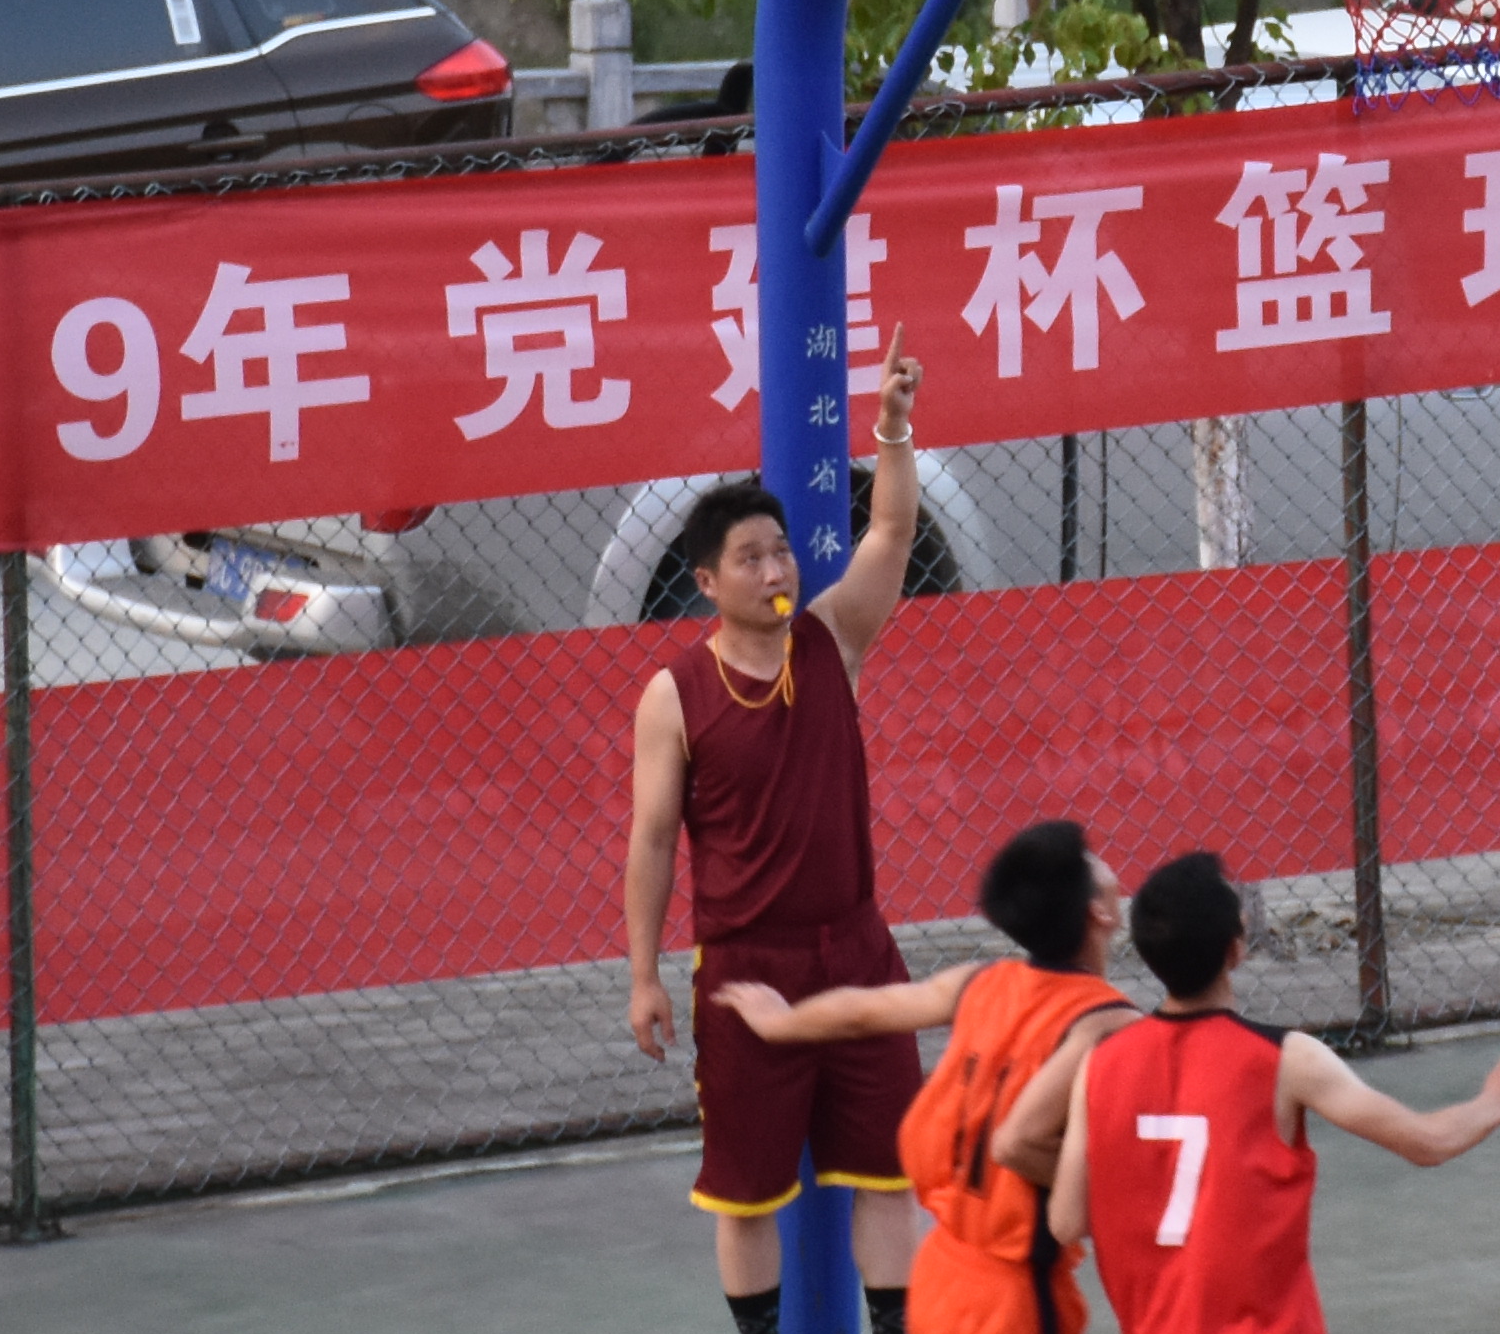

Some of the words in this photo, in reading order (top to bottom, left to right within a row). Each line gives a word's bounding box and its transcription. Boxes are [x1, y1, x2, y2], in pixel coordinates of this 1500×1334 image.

[806, 323, 842, 562] 湖北省体
[1137, 1115, 1209, 1247] 7
